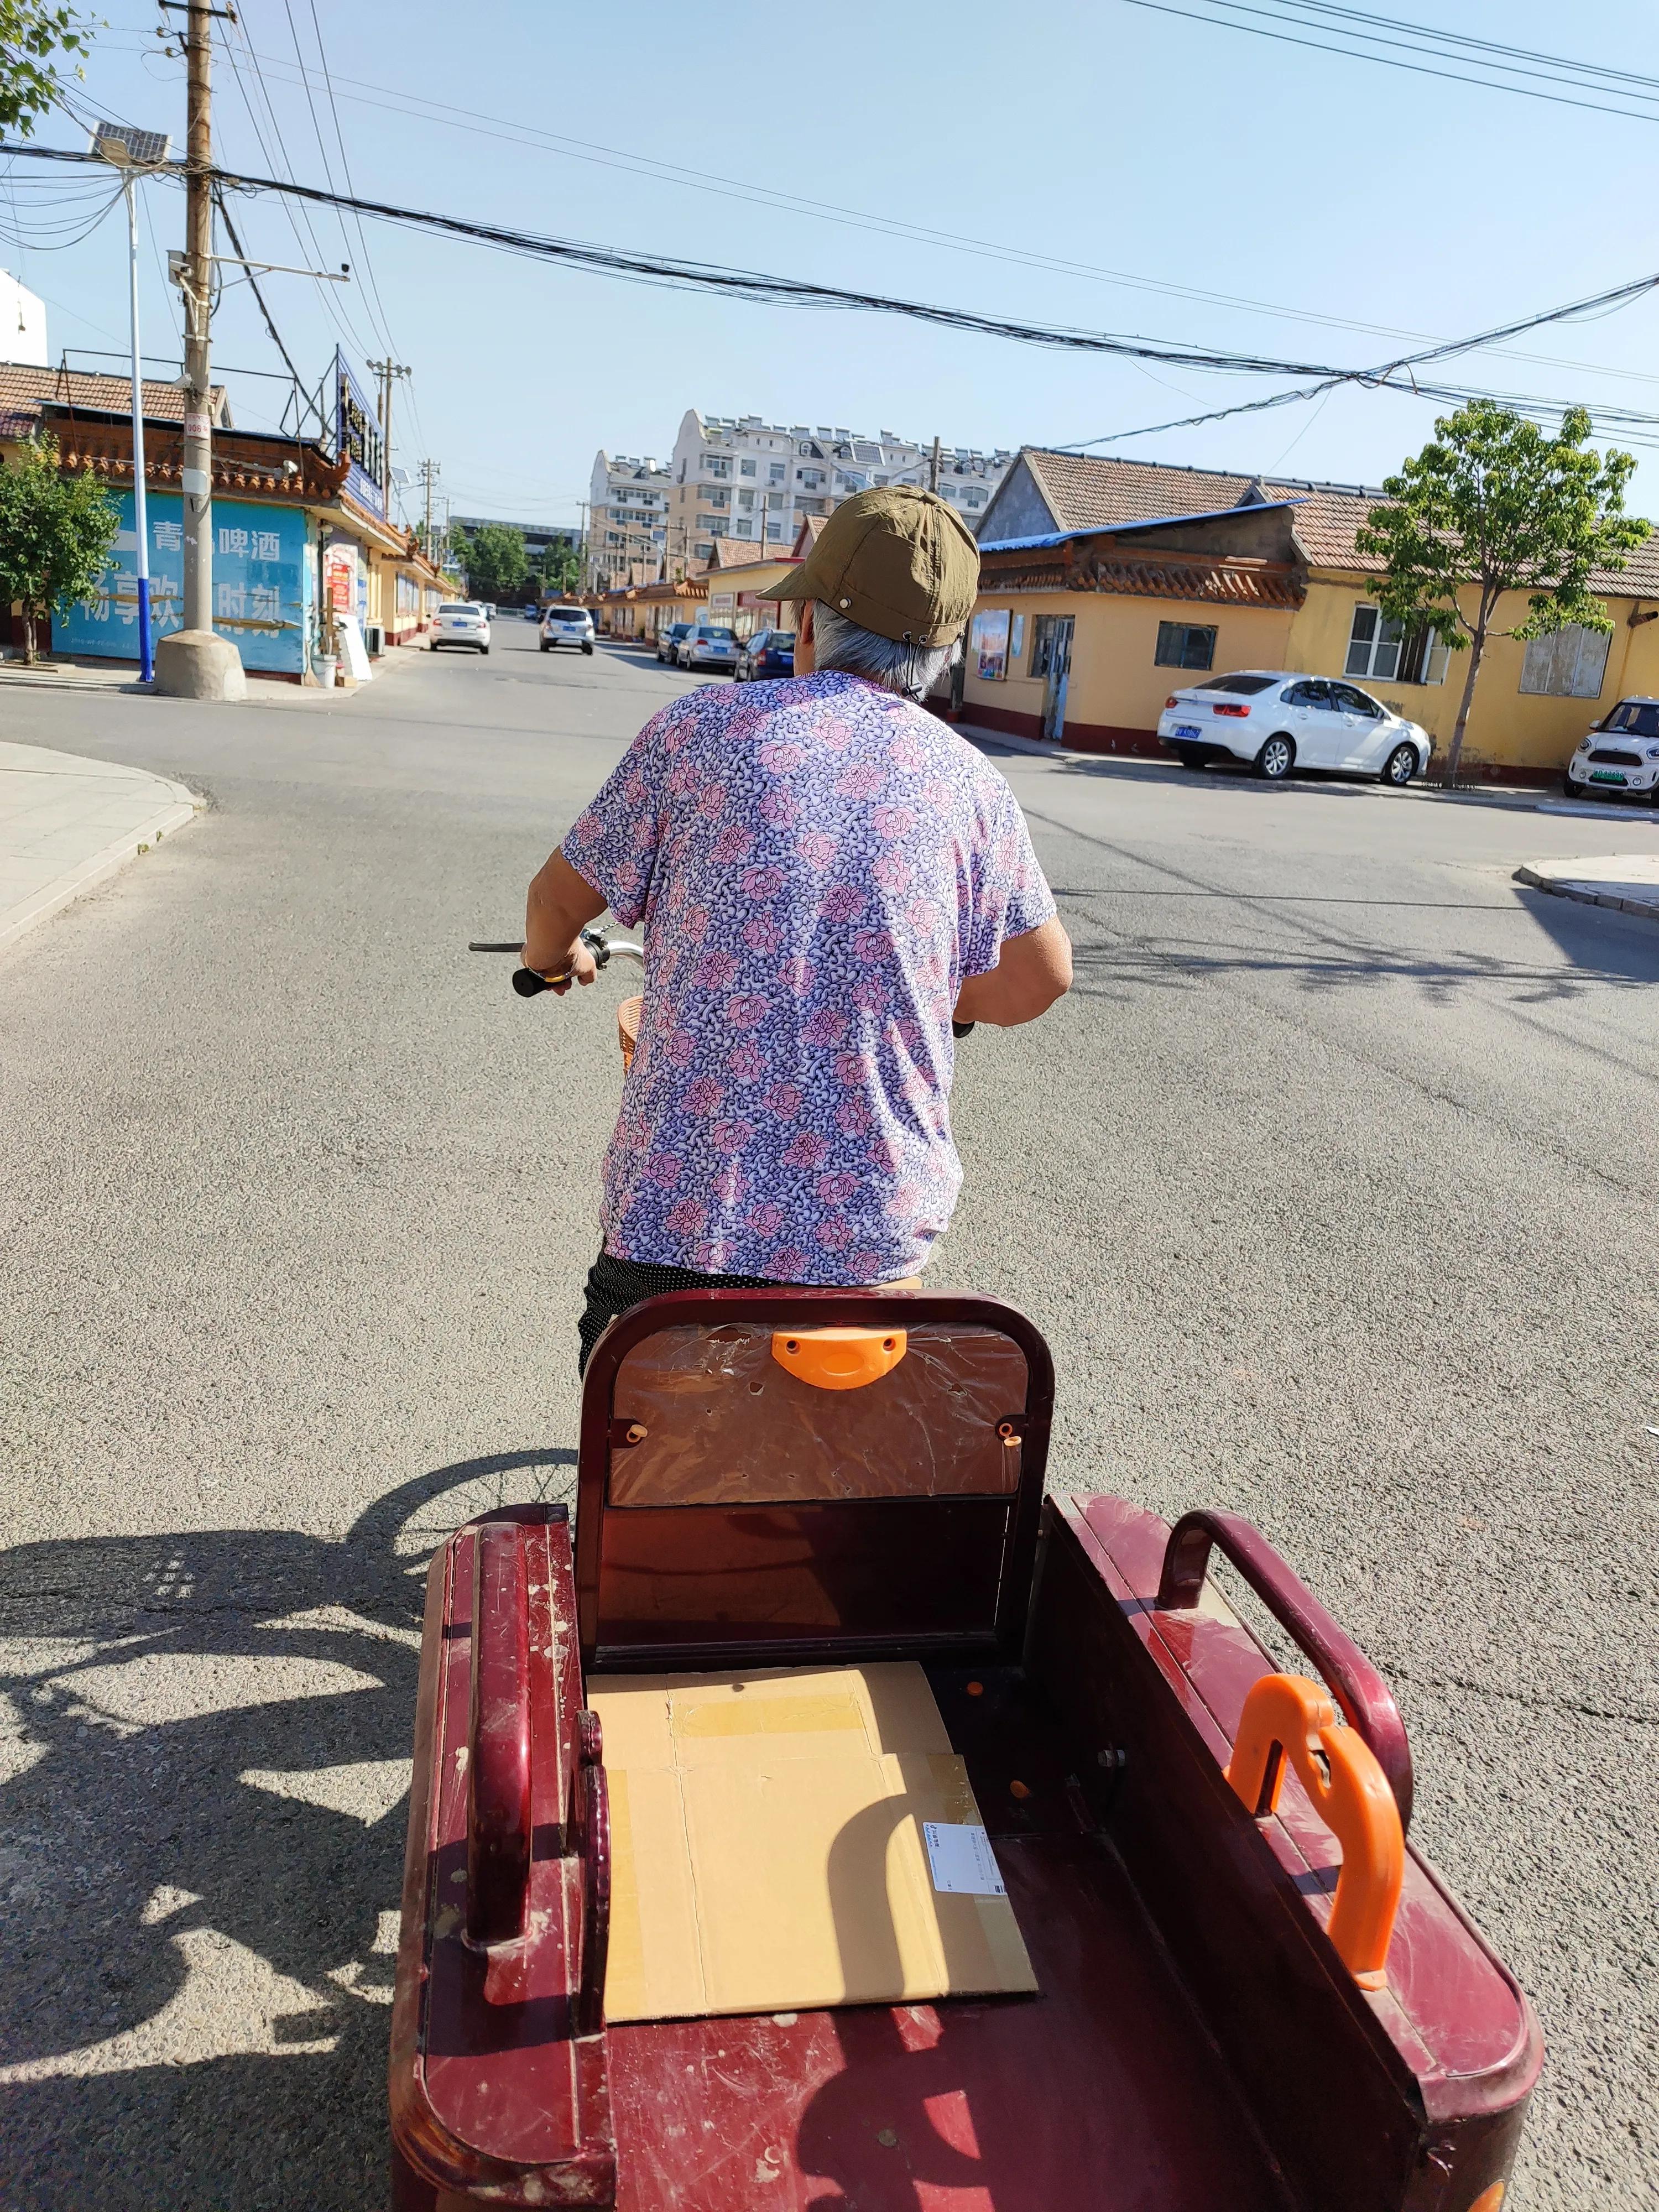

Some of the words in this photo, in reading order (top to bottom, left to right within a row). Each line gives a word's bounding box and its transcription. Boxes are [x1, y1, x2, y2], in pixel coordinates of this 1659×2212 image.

[153, 521, 280, 561] 青啤酒
[80, 571, 280, 639] 畅享欢时刻
